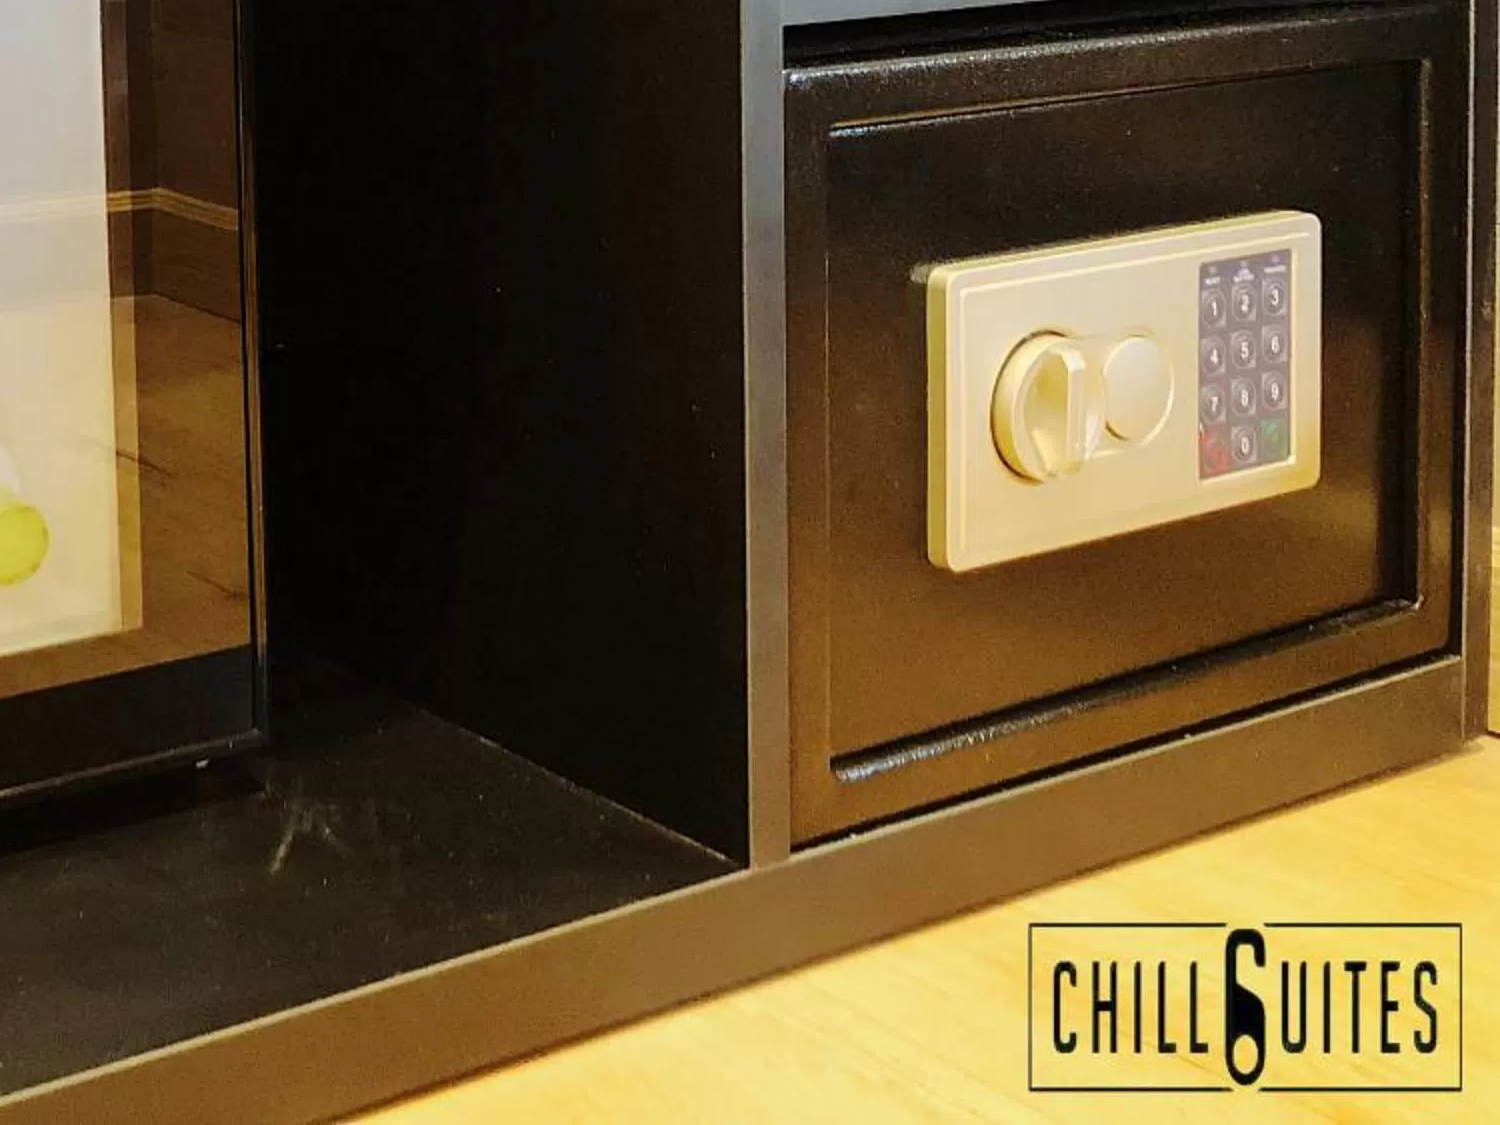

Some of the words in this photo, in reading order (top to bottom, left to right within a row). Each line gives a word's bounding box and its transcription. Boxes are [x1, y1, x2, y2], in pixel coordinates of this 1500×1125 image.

[1210, 300, 1218, 316] 1
[1241, 294, 1249, 312] 2
[1271, 289, 1279, 306] 3
[1210, 347, 1218, 363] 4
[1241, 341, 1249, 359] 5
[1271, 335, 1279, 354] 6
[1211, 396, 1219, 412] 7
[1241, 389, 1249, 406] 8
[1271, 383, 1279, 401] 9
[1241, 437, 1249, 453] 0
